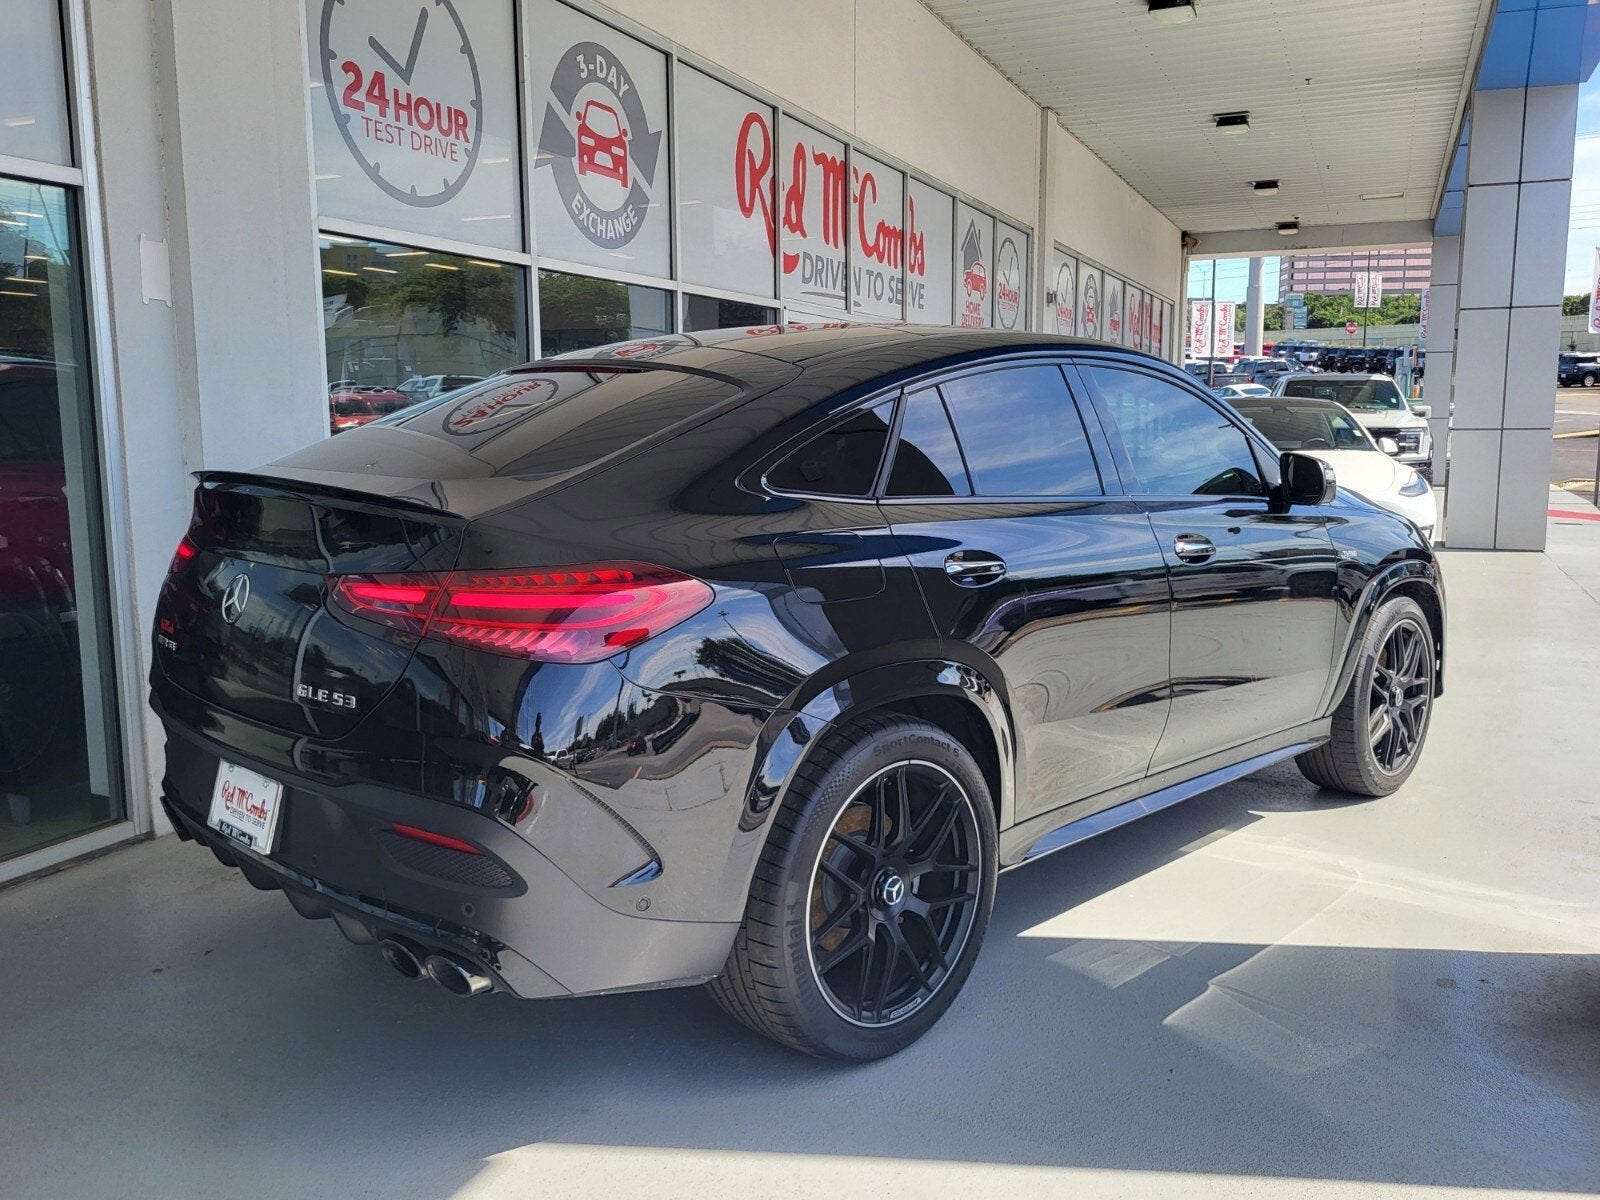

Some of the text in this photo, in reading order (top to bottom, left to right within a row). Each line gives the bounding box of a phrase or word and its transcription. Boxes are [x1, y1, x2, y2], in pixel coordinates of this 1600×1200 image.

[577, 54, 630, 98] 3-DAY
[341, 61, 470, 144] 24 HOUR
[362, 115, 459, 162] TEST DRIVE
[572, 193, 638, 240] EXCHANGE
[866, 269, 884, 301] TO
[888, 275, 925, 310] SEVE
[966, 300, 981, 315] HOME
[961, 313, 985, 328] DELIVERY
[297, 684, 356, 708] GLE 53
[222, 780, 267, 820] Red McCombs
